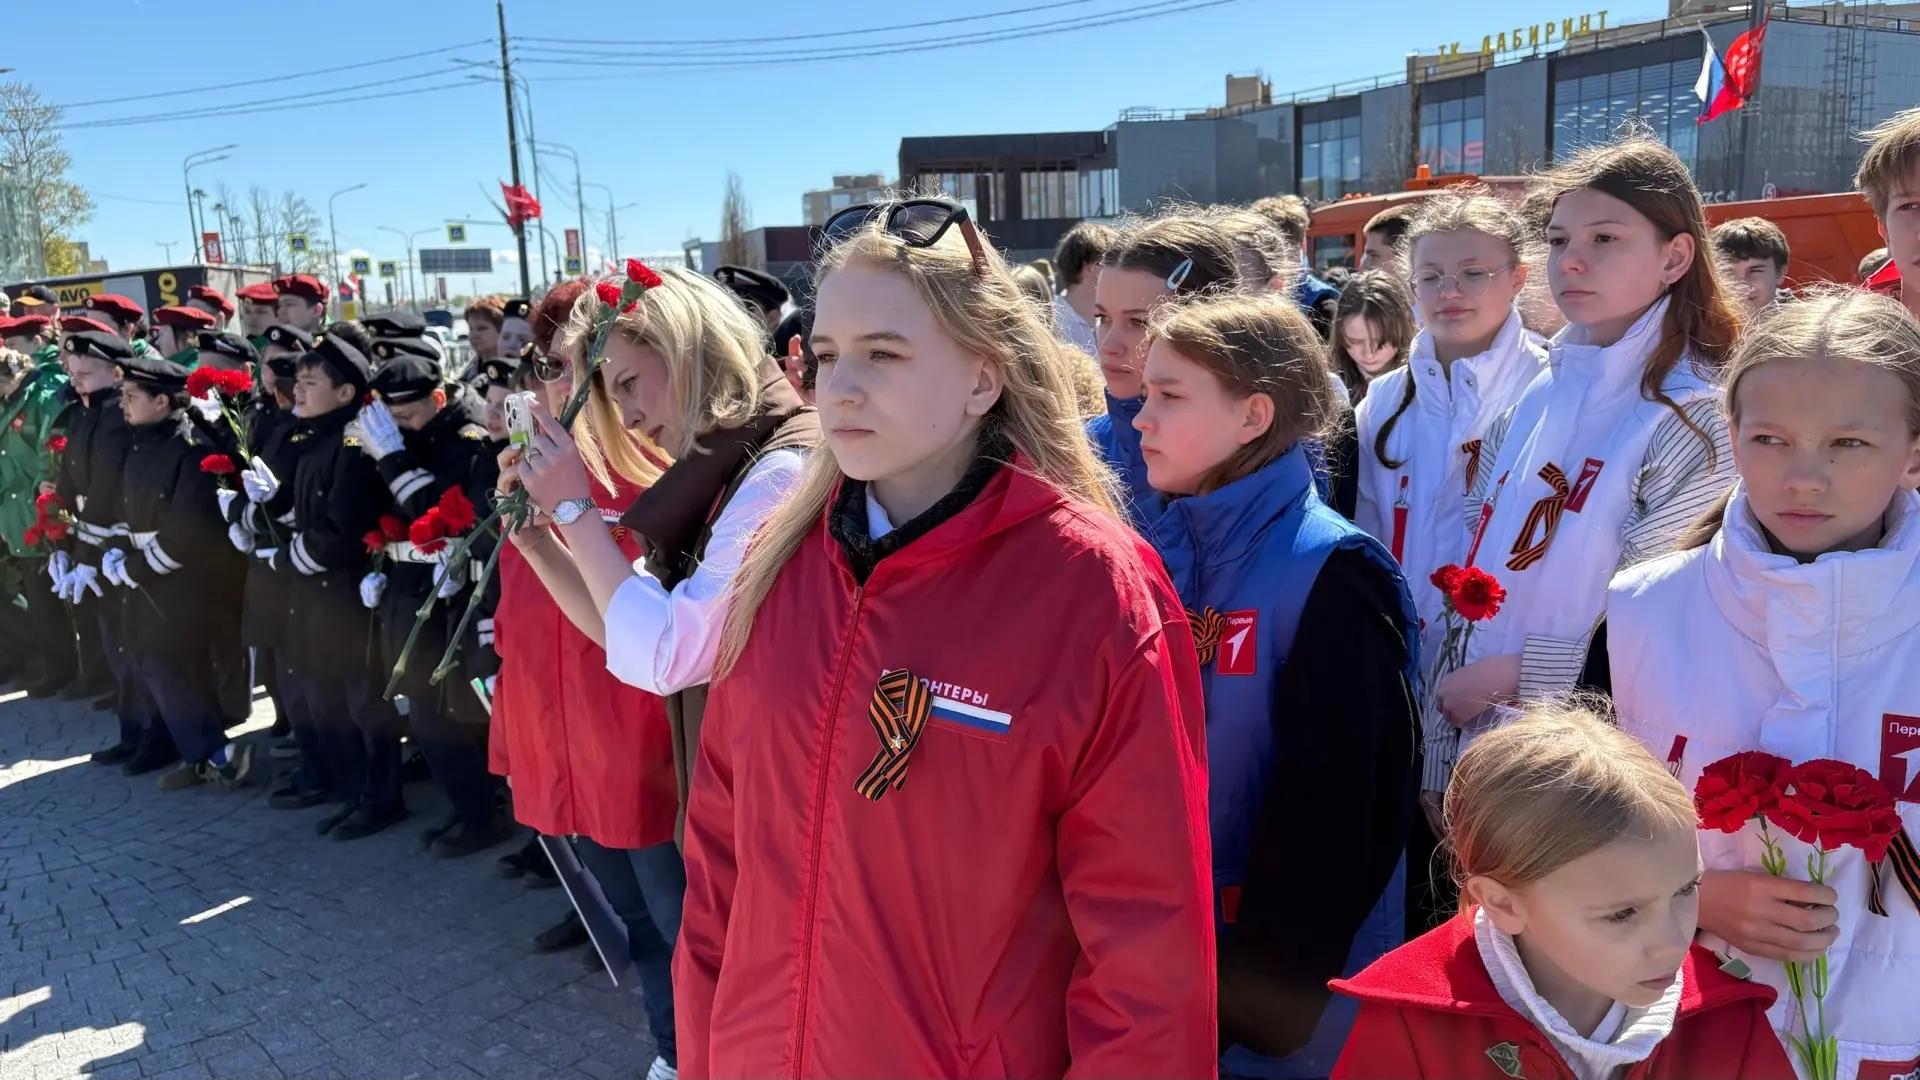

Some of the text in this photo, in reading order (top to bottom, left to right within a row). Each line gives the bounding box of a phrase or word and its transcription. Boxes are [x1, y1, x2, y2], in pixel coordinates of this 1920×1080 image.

[1438, 10, 1608, 63] ТК ЛАБИРИНТ
[60, 287, 90, 303] AVO
[881, 669, 989, 706] ОНТЕРЫ
[1888, 722, 1920, 738] Пер
